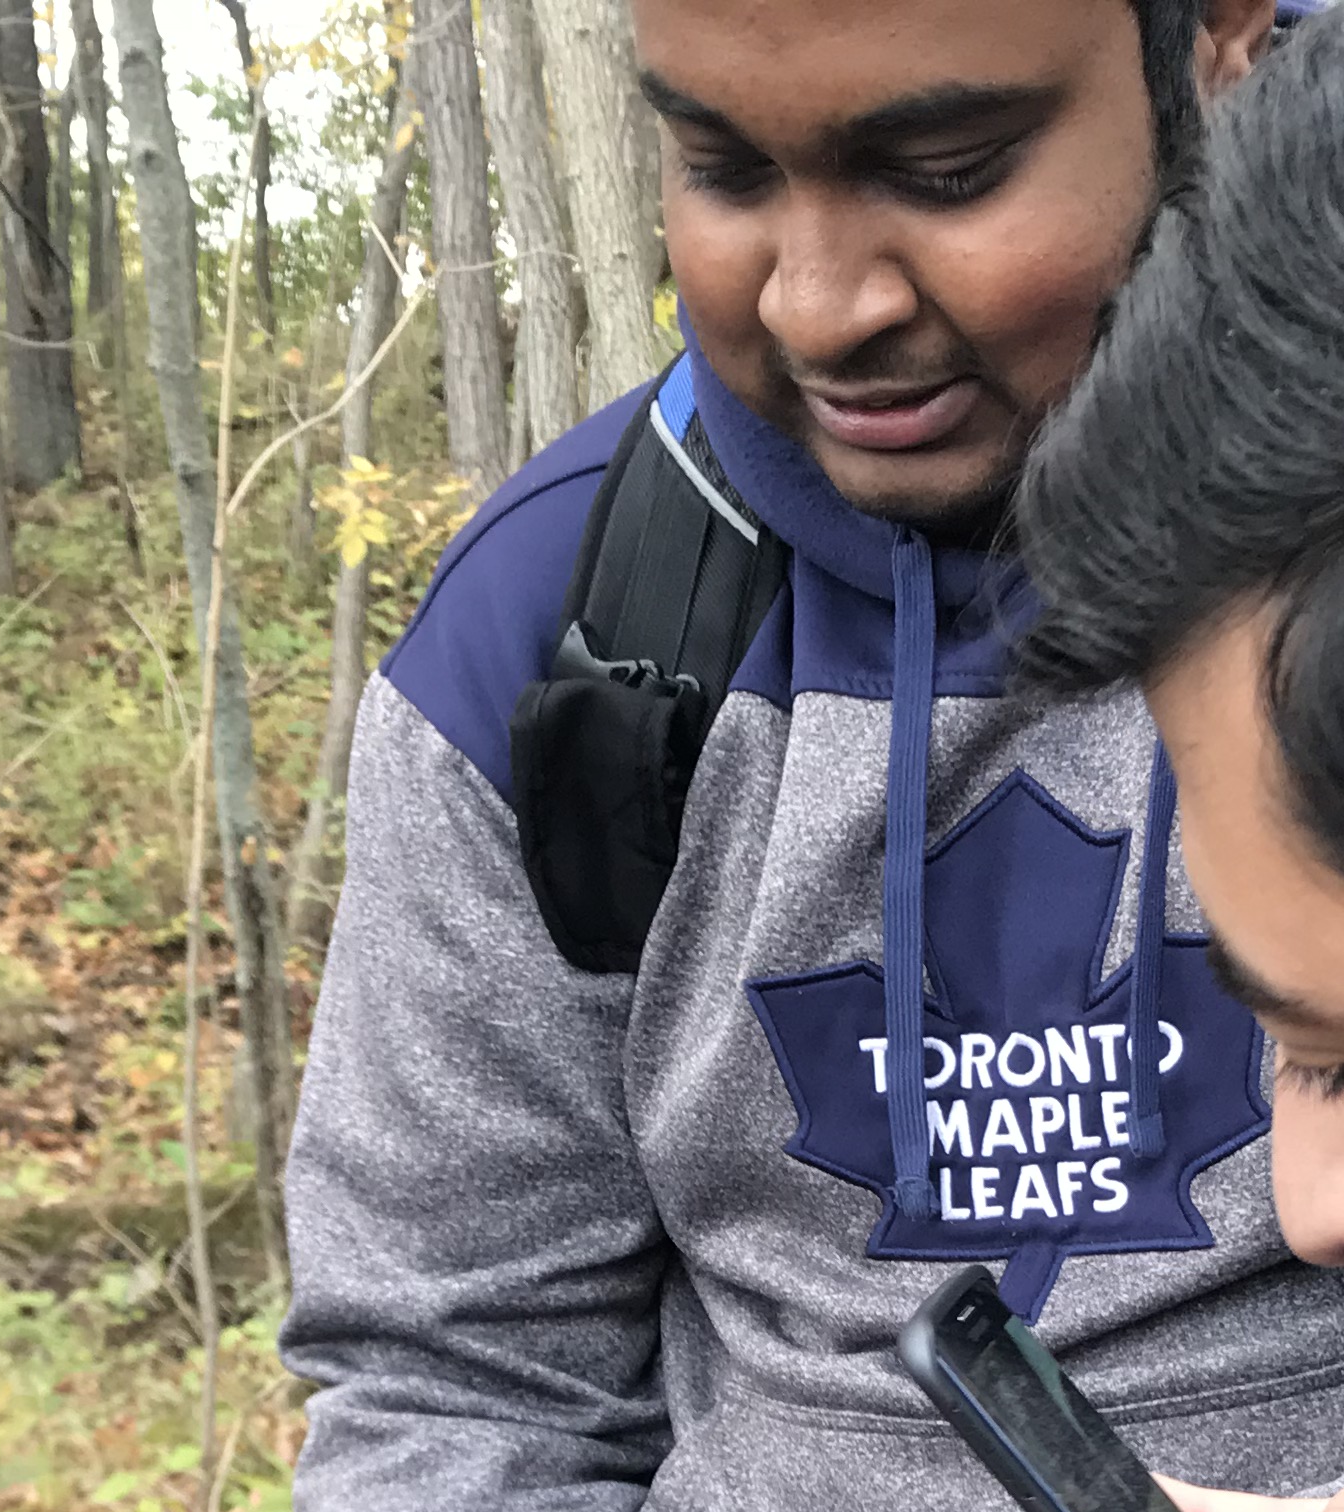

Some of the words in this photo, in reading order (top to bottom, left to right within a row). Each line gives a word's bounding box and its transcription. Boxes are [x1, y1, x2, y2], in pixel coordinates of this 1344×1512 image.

[859, 1021, 1184, 1092] TORONTO
[926, 1092, 1130, 1156] MAPLE
[940, 1157, 1129, 1220] LEAFS
